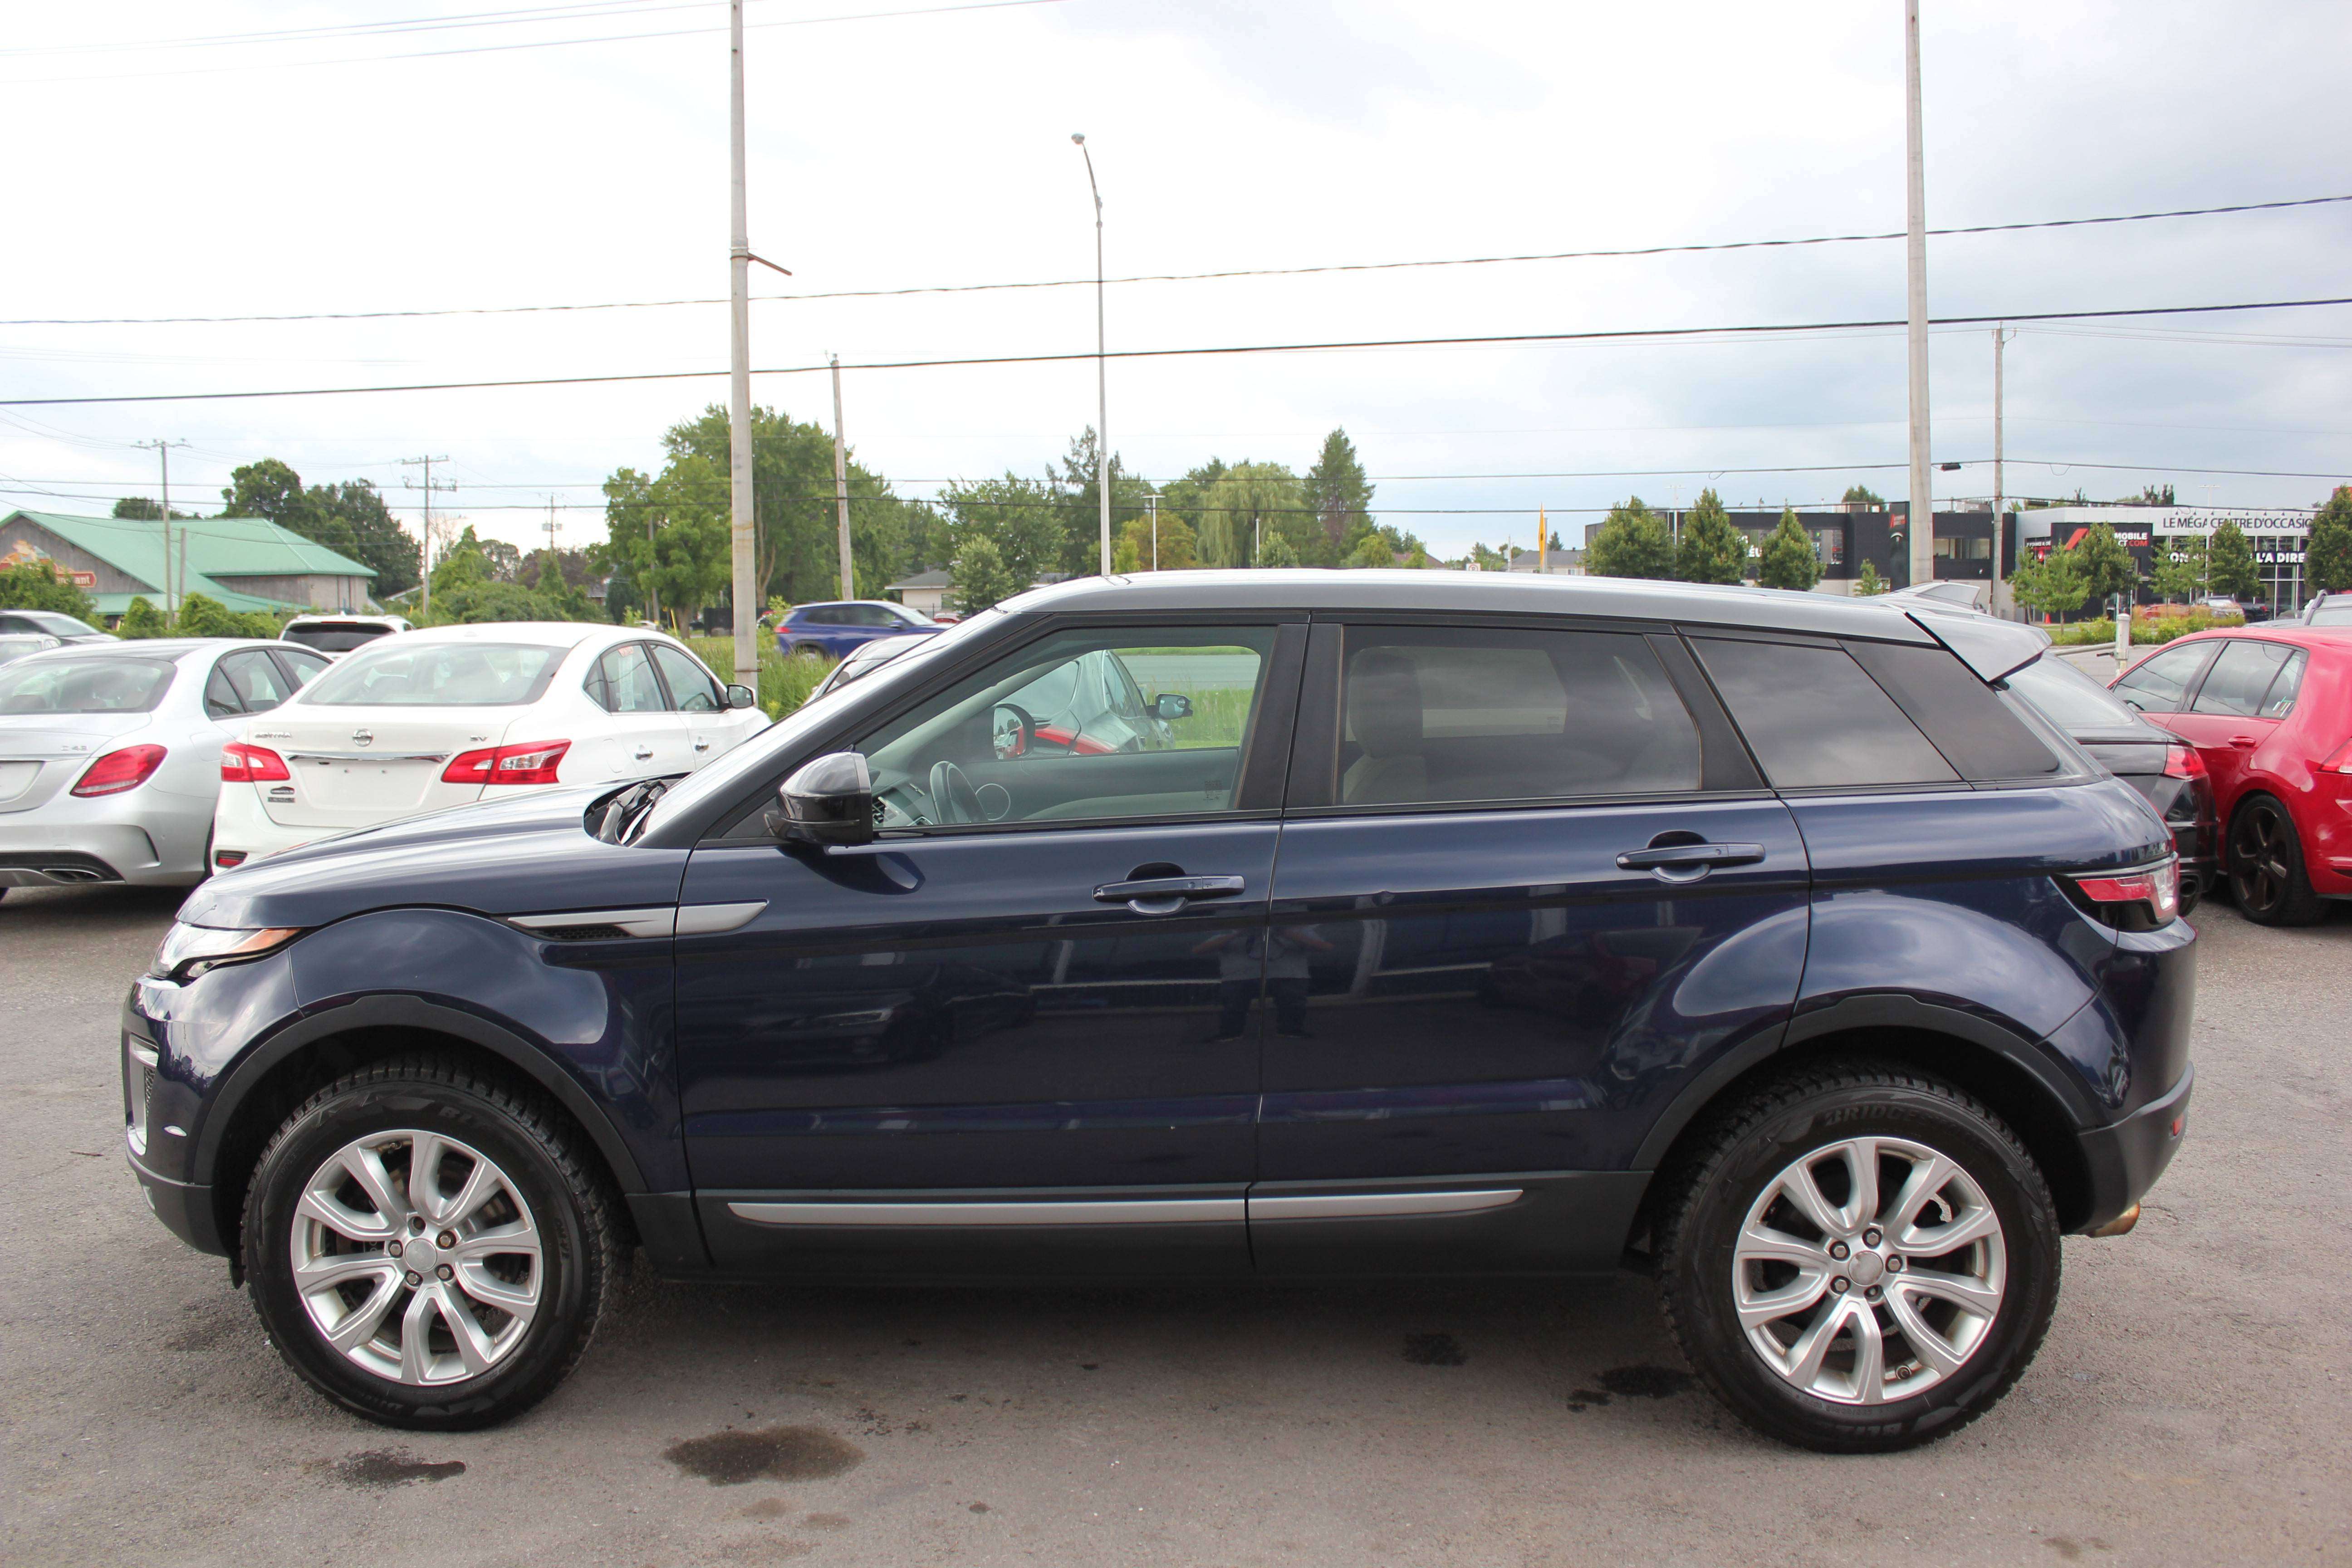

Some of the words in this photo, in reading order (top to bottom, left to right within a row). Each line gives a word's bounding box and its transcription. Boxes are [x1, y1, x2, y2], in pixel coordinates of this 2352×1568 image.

[2163, 518, 2175, 528] LE
[2254, 518, 2313, 529] D'OCCASIO
[2114, 532, 2148, 540] MOBILE
[2276, 553, 2305, 563] DIRE
